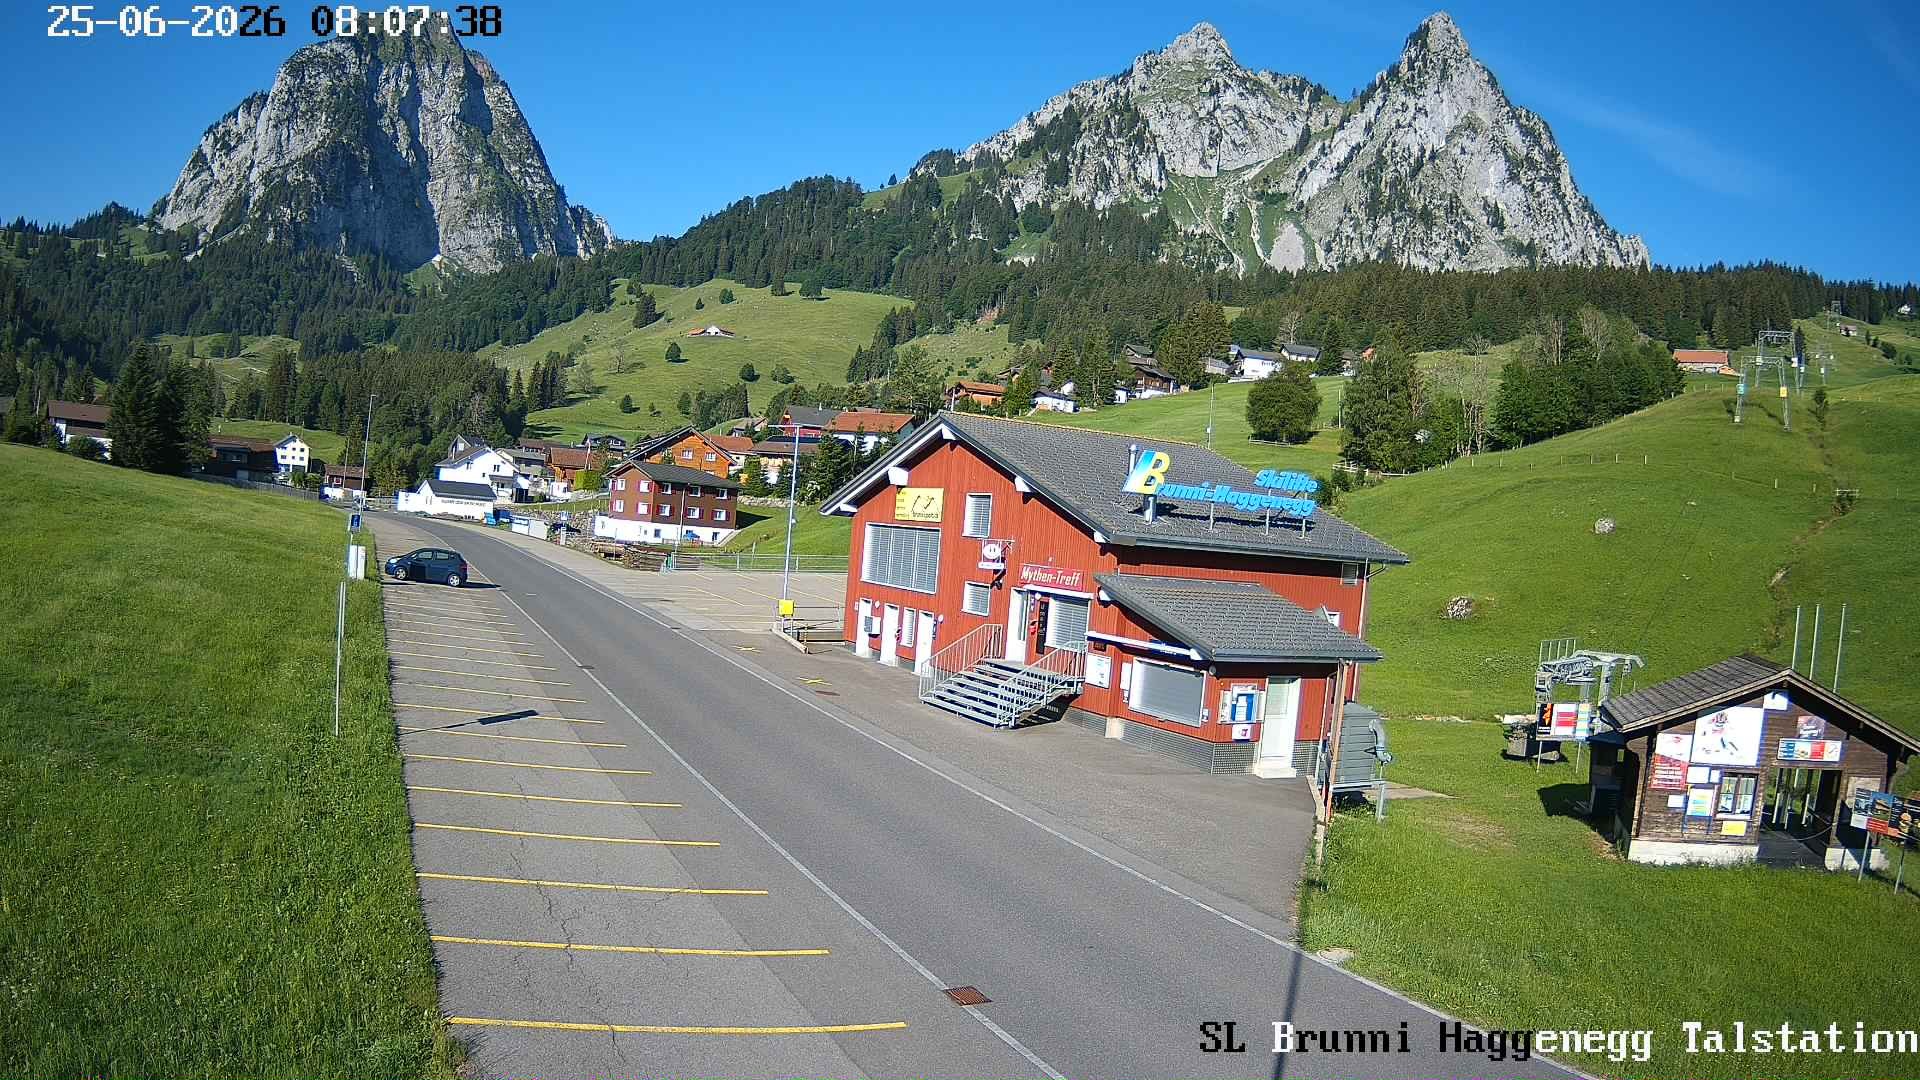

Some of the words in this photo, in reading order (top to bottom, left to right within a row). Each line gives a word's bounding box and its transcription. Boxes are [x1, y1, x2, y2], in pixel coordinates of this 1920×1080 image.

[1122, 450, 1317, 518] Brunni-Haggenegg
[1254, 469, 1319, 493] Skilifte
[1021, 566, 1080, 587] Mythen-Treff
